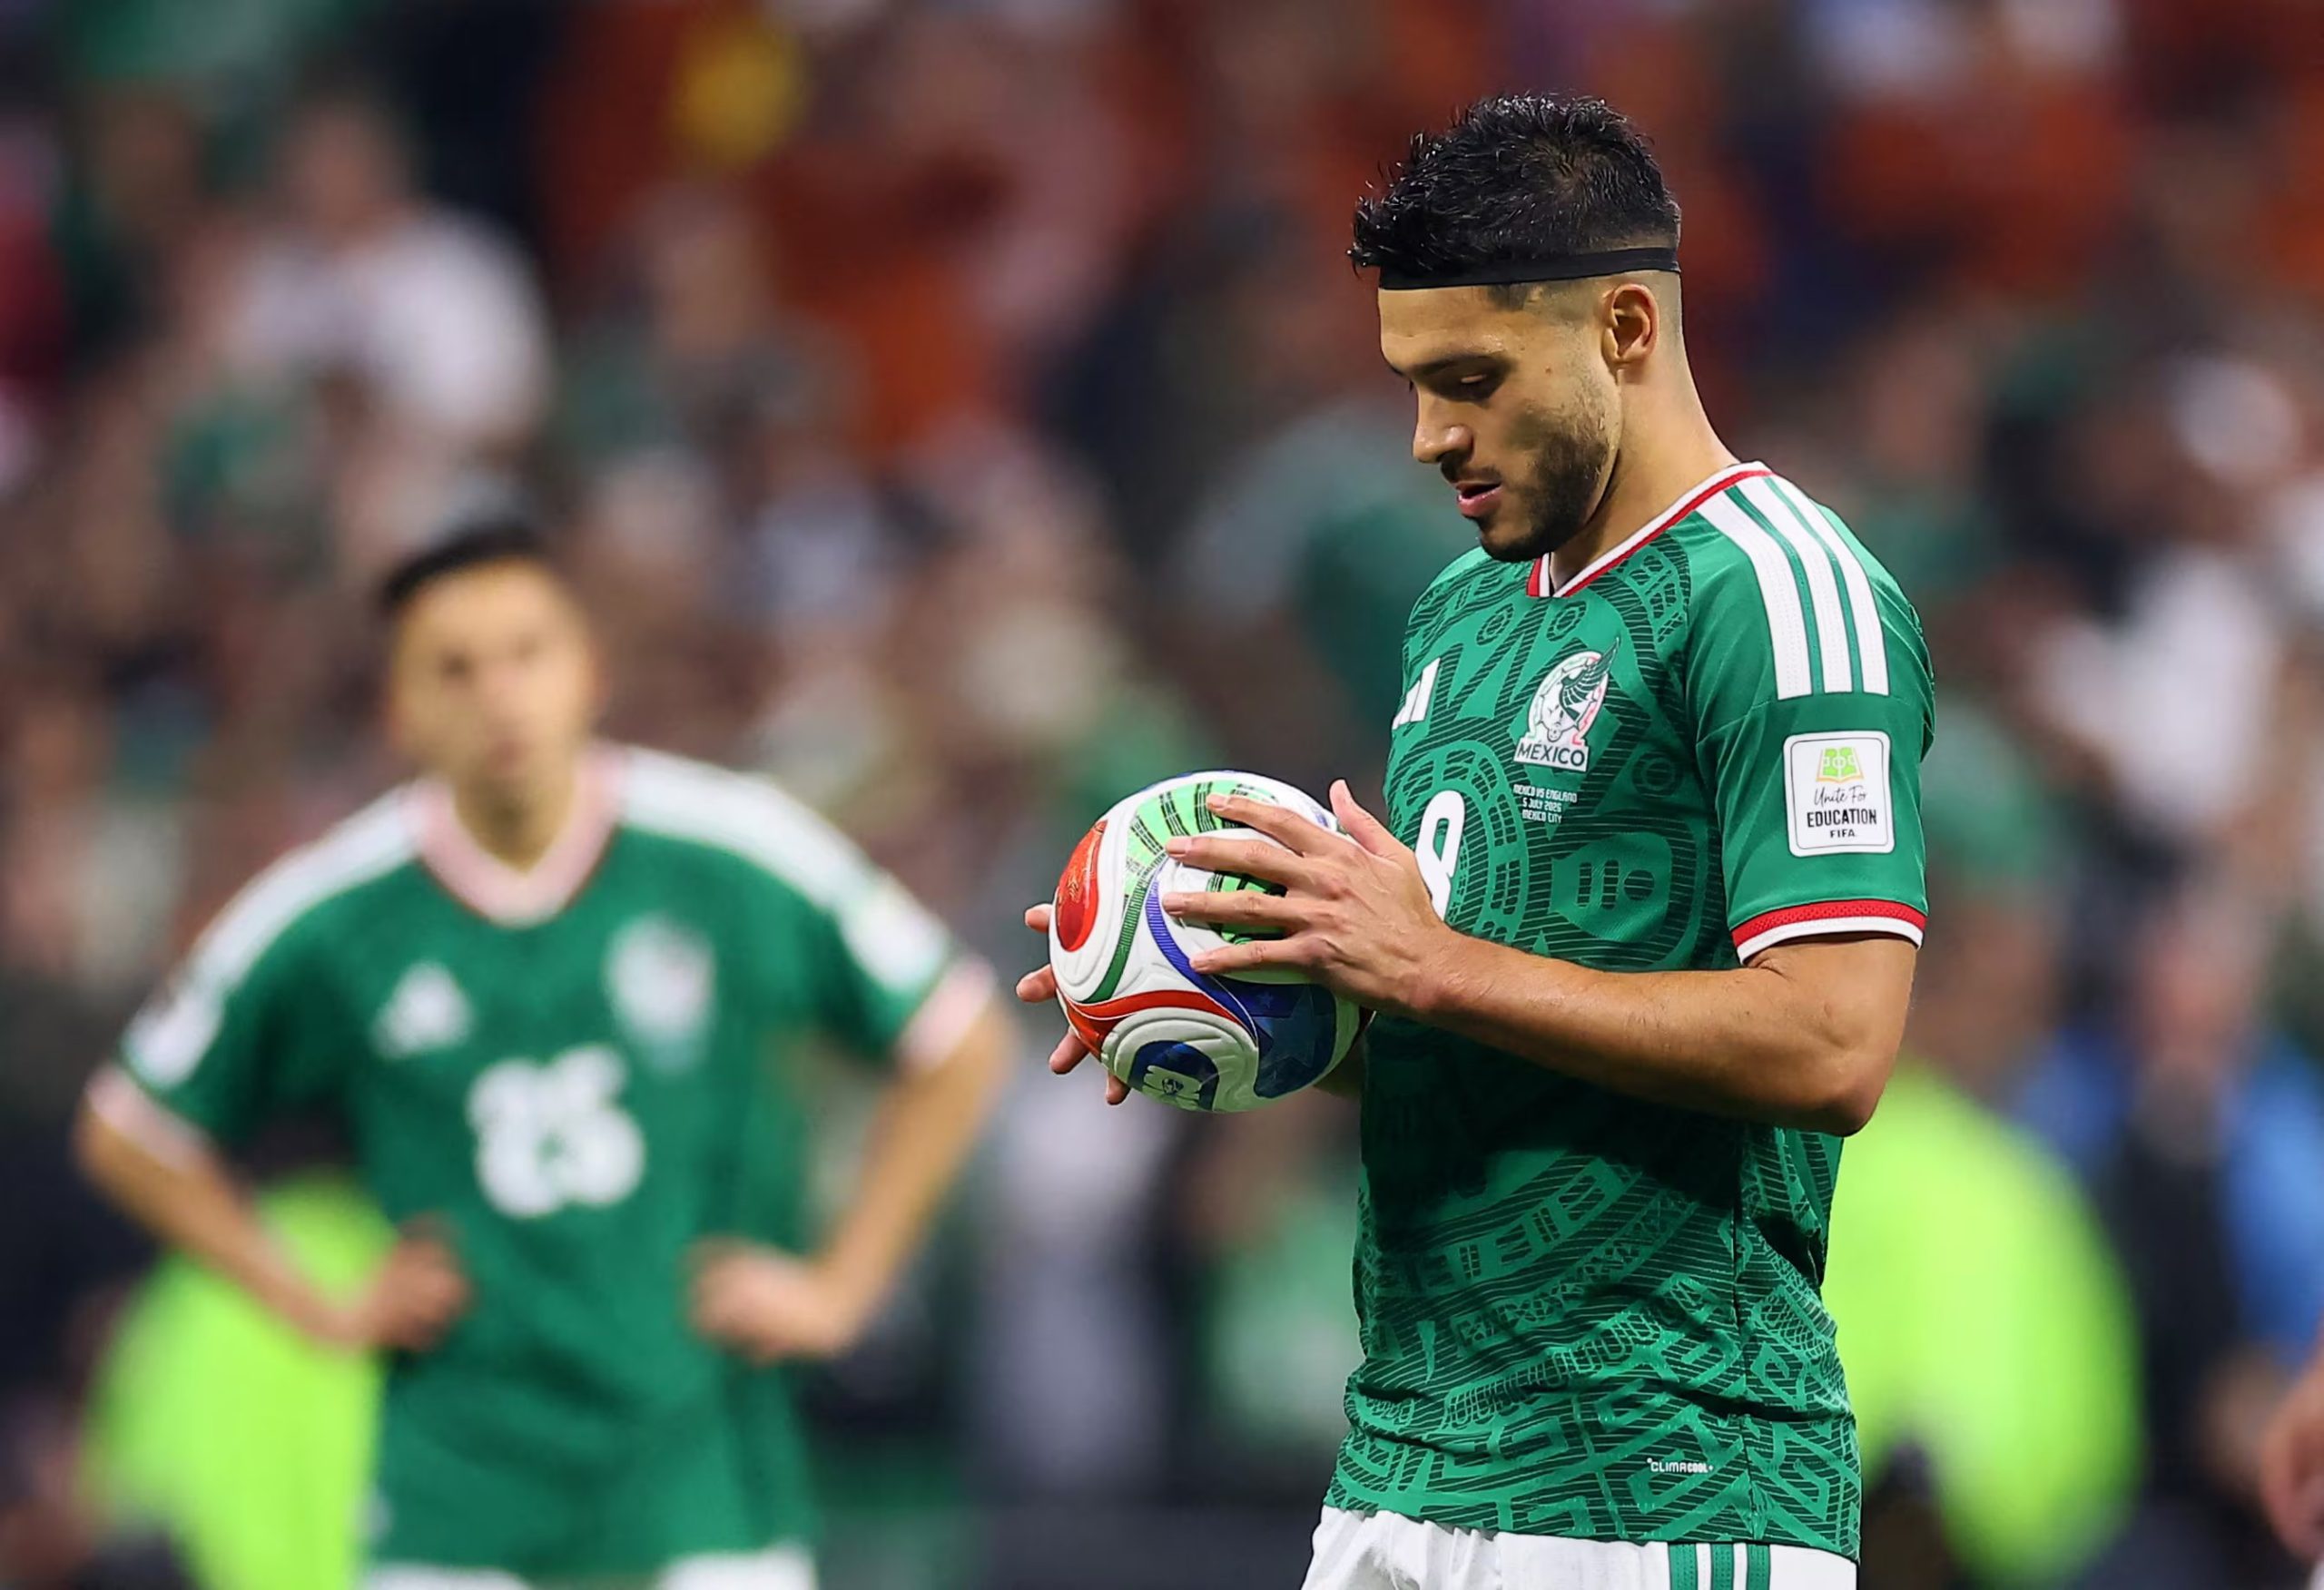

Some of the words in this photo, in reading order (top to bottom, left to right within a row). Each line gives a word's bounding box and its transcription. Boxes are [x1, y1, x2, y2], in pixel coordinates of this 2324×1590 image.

[1512, 784, 1535, 797] MEXICO
[1546, 789, 1578, 803] ENGLAND
[1814, 786, 1846, 808] Unite
[1849, 785, 1867, 804] For
[1522, 797, 1528, 808] 5
[1529, 798, 1543, 810] JULY
[1522, 809, 1546, 822] MEXICO
[1548, 811, 1562, 823] CITY
[1807, 809, 1877, 828] EDUCATION
[1830, 829, 1856, 838] FIFA
